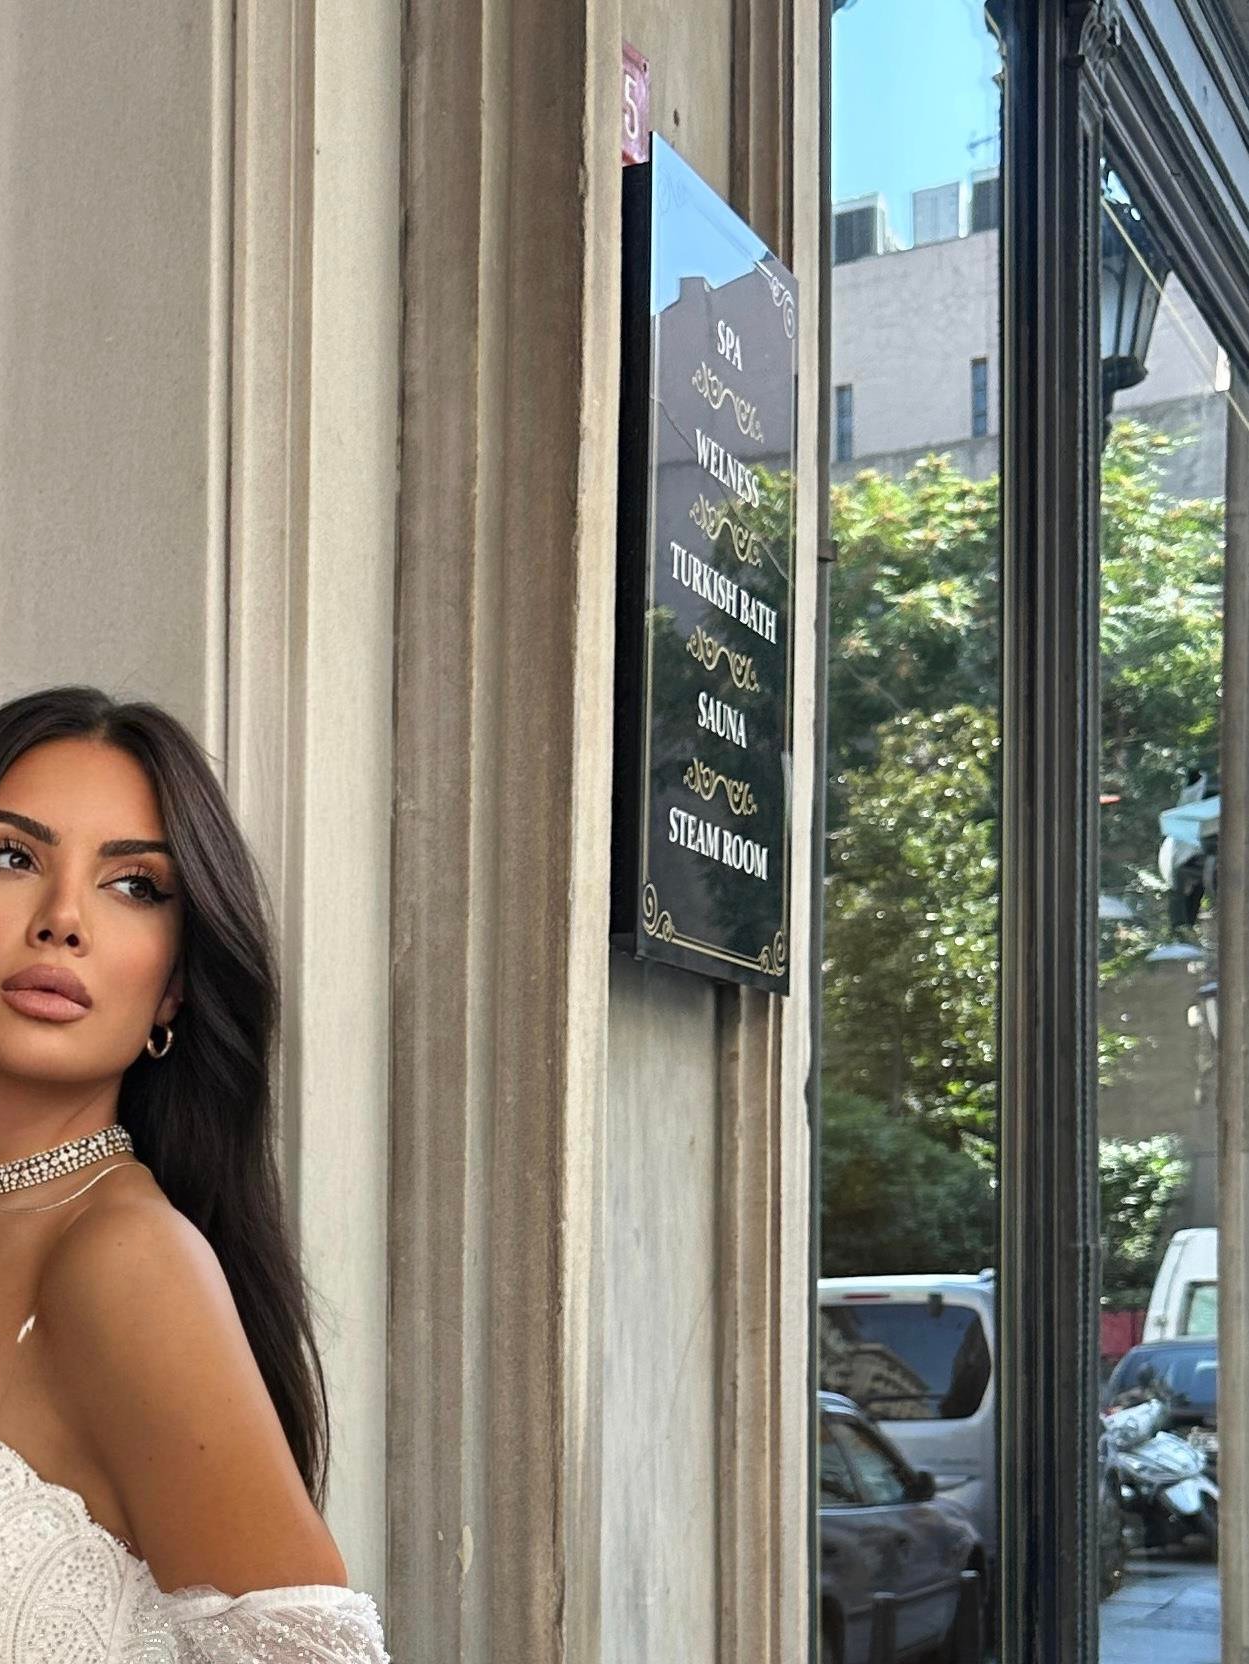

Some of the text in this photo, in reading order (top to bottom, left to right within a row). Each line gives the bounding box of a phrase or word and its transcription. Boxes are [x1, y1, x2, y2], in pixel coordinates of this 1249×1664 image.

[716, 319, 743, 373] SPA
[694, 428, 760, 508] WELNESS
[670, 541, 777, 645] TURKISH BATH
[697, 691, 747, 749] SAUNA
[668, 806, 768, 881] STEAM ROOM
